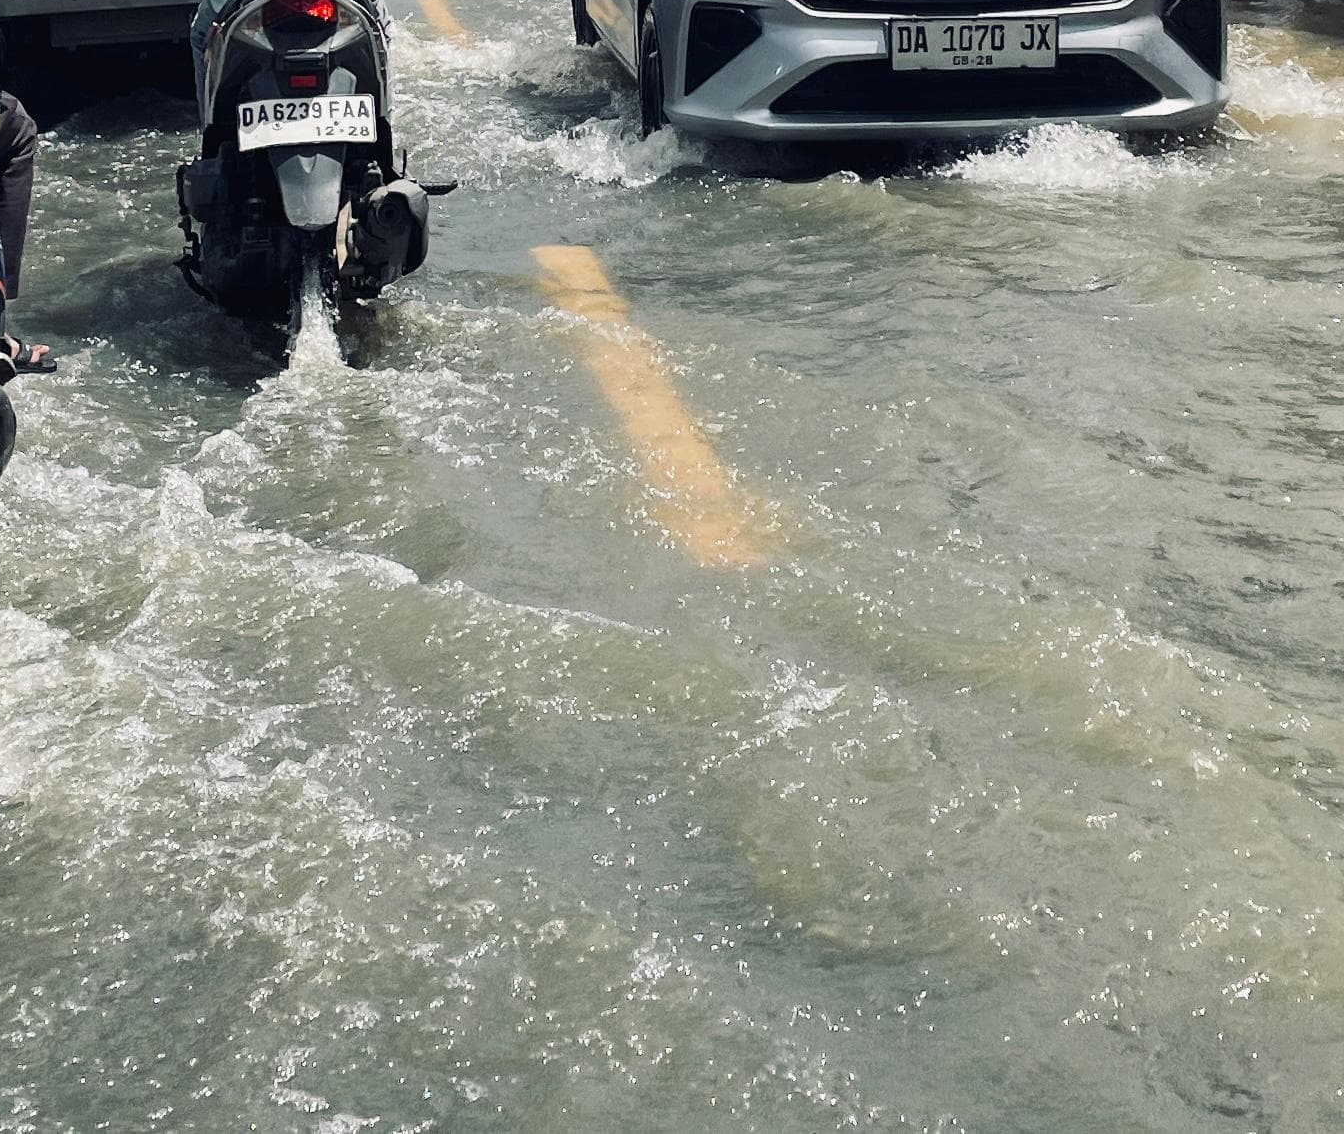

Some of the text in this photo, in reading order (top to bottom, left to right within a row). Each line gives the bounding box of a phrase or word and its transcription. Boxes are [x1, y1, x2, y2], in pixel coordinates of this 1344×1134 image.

[897, 23, 1051, 54] DA 1070 JX
